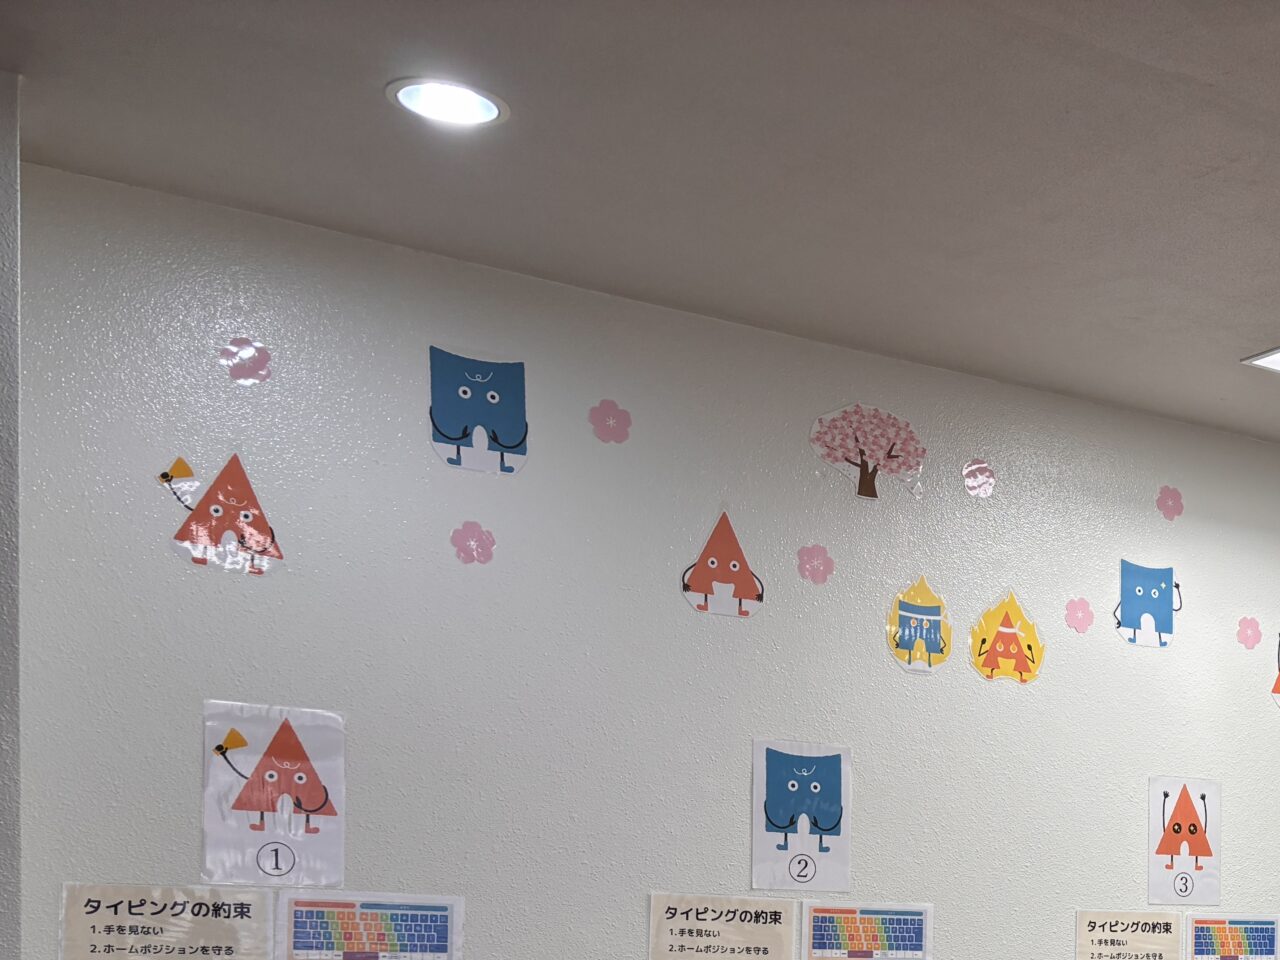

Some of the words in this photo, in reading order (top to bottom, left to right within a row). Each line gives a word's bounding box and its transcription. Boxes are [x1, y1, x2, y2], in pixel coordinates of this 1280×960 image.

[84, 898, 252, 919] タイピングの約束
[665, 905, 783, 925] タイピングの約束
[1087, 920, 1173, 934] タイピングの約束
